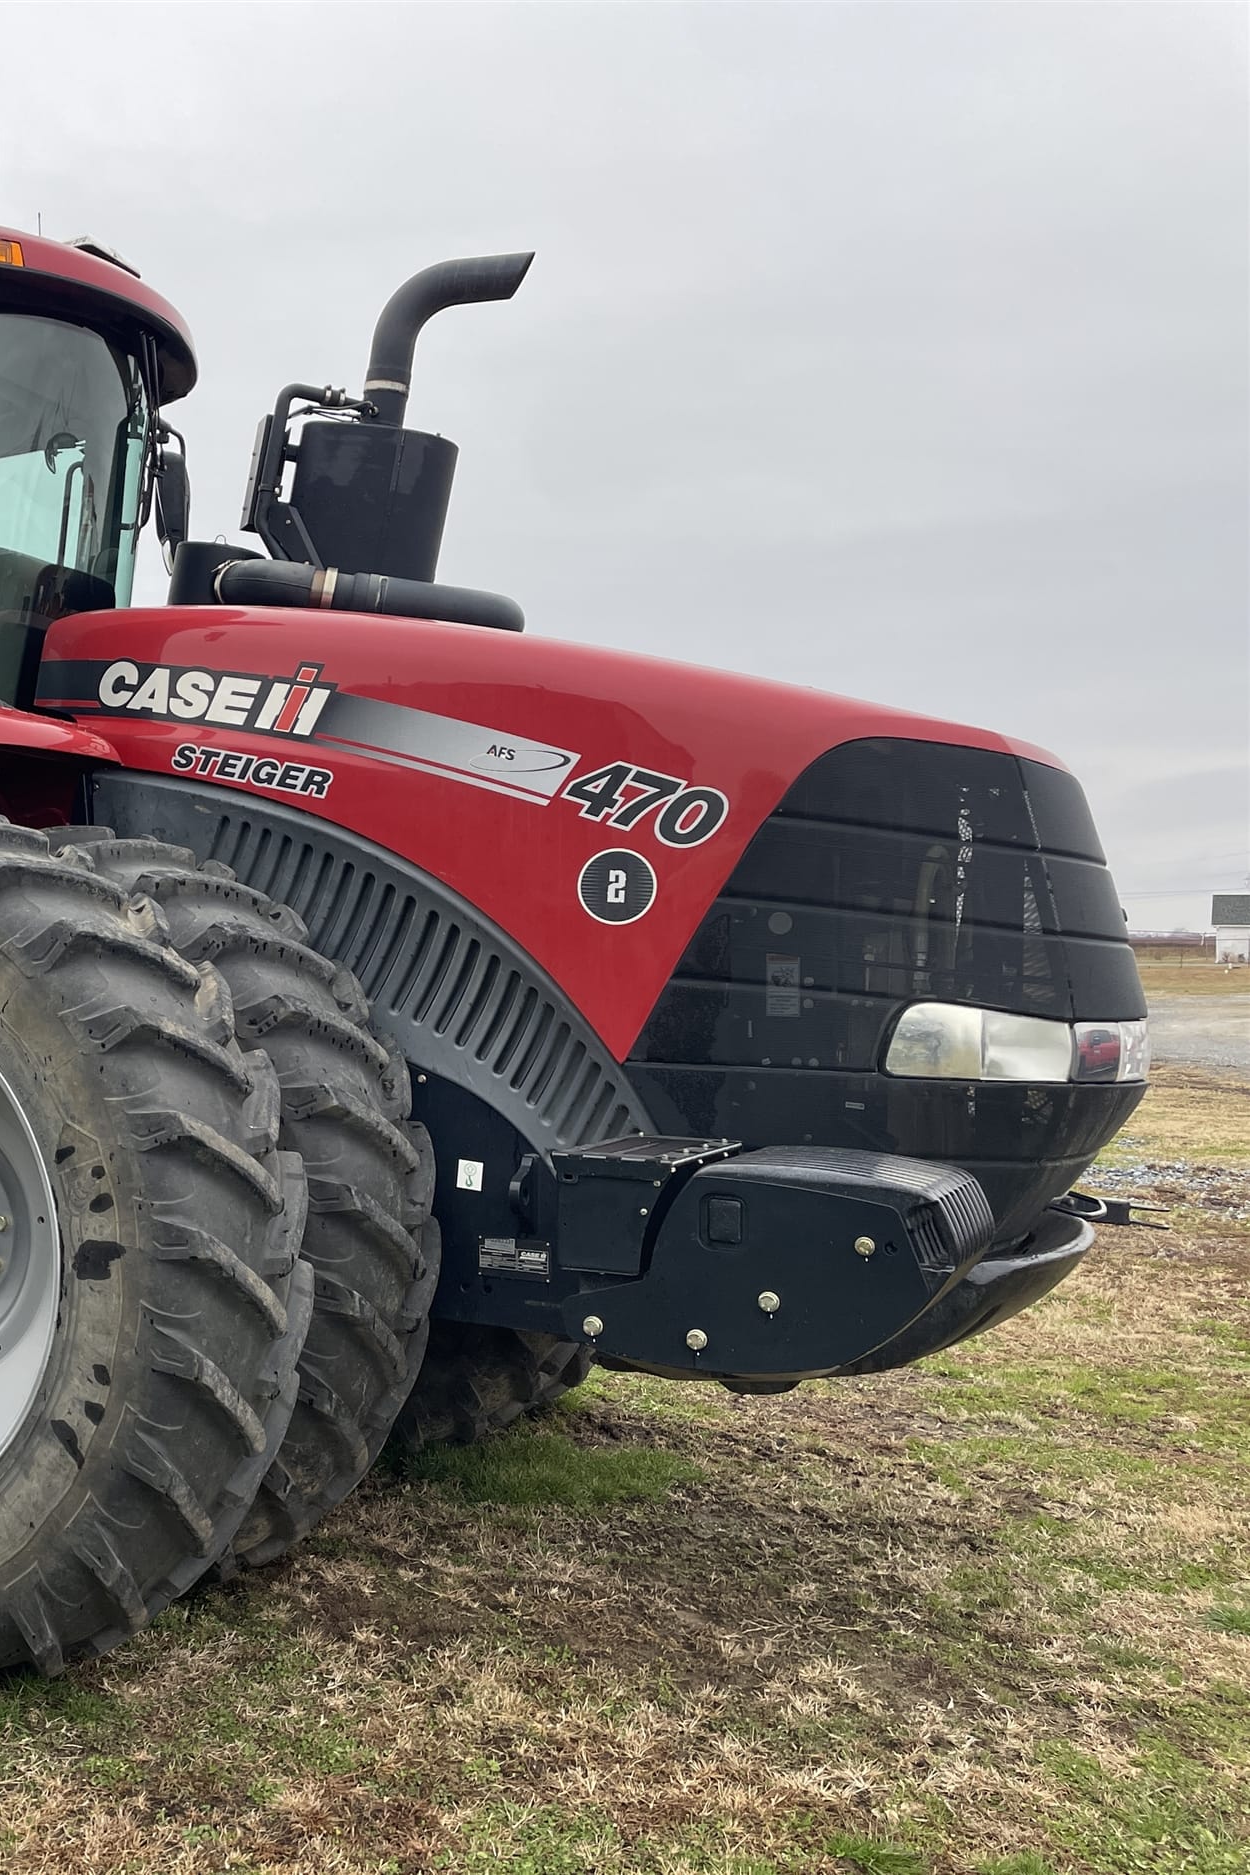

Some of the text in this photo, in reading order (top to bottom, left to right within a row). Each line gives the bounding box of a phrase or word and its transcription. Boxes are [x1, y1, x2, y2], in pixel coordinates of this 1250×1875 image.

[99, 661, 262, 726] CASE
[172, 744, 333, 798] STEIGER
[486, 744, 516, 761] AFS
[561, 762, 729, 848] 470
[607, 869, 627, 903] 2
